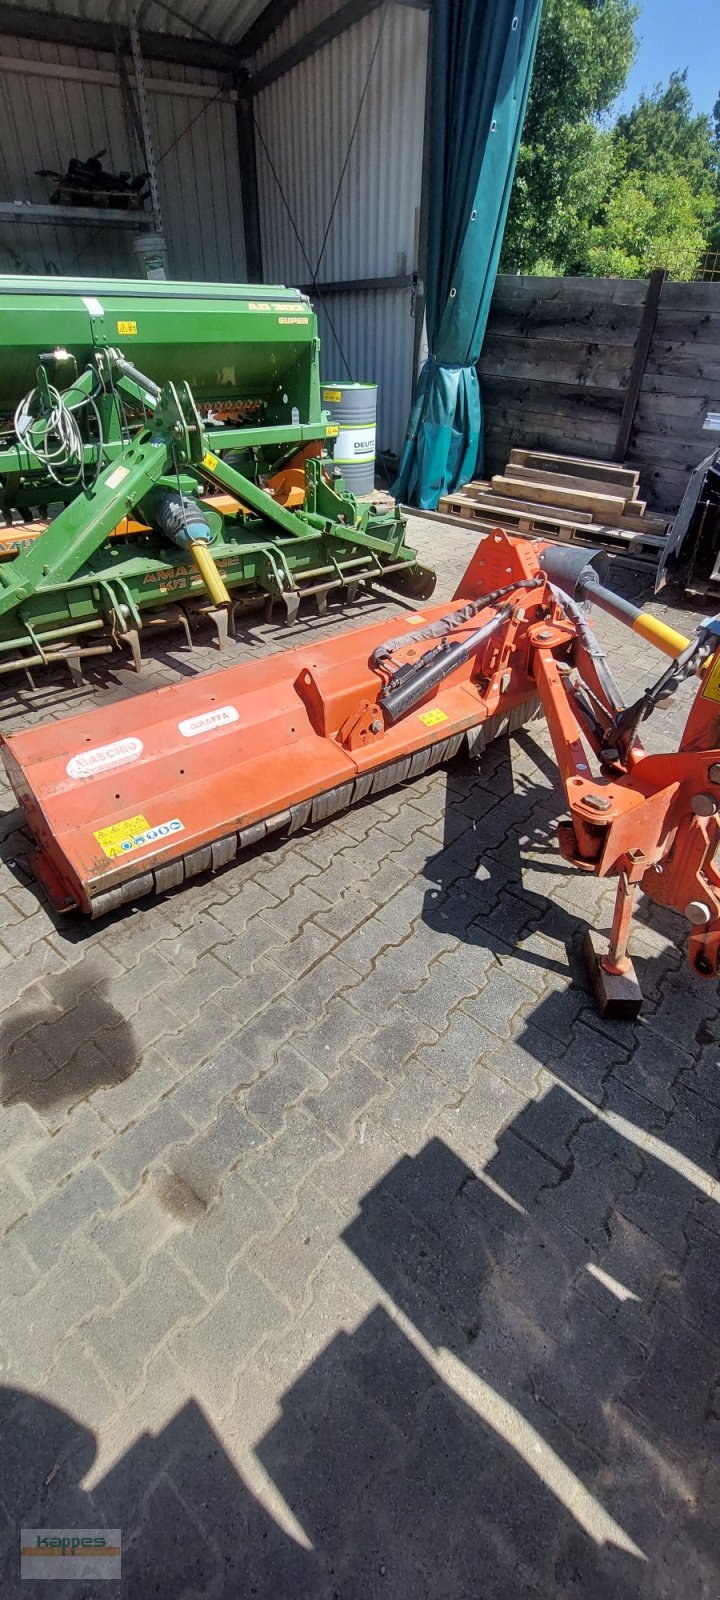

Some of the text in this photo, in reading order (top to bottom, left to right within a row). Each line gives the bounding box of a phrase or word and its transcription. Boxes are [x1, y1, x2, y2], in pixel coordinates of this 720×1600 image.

[278, 317, 309, 326] SUPER
[143, 556, 240, 585] AMAZNE
[189, 711, 230, 730] GIRAFFA
[75, 741, 137, 767] MASCHIO
